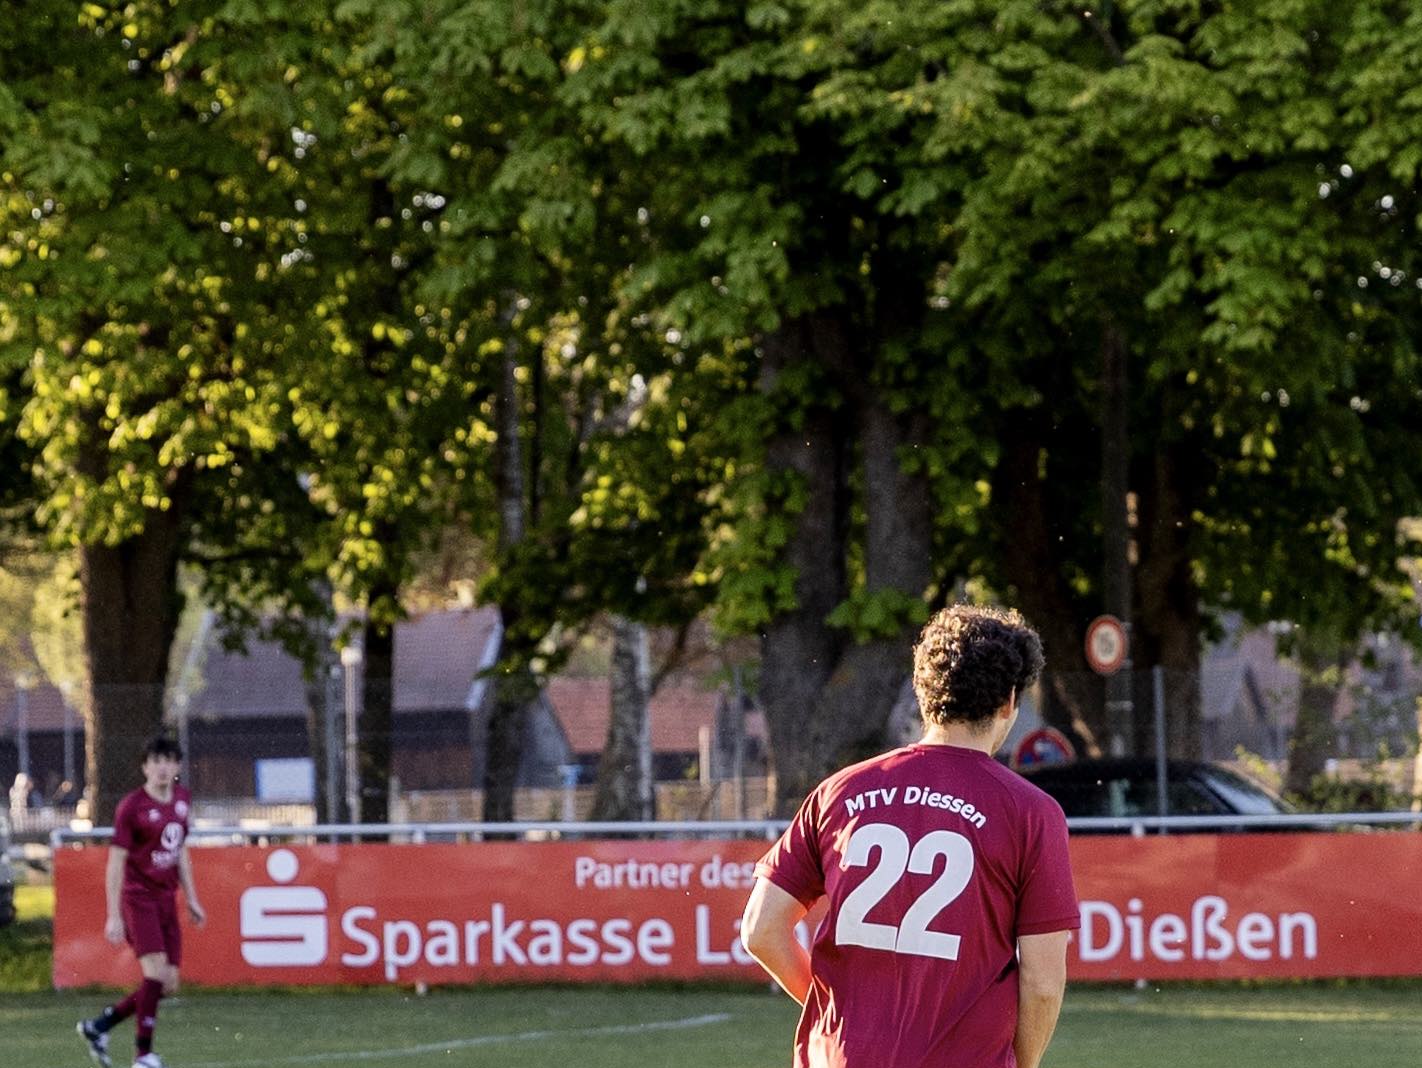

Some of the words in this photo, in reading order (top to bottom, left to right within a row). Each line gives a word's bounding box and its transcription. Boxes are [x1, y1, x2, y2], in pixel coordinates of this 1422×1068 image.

[845, 787, 898, 817] MTV
[904, 786, 987, 829] Diessen
[575, 856, 694, 889] Partner
[700, 854, 755, 889] des
[835, 823, 974, 961] 22
[341, 903, 675, 981] Sparkasse
